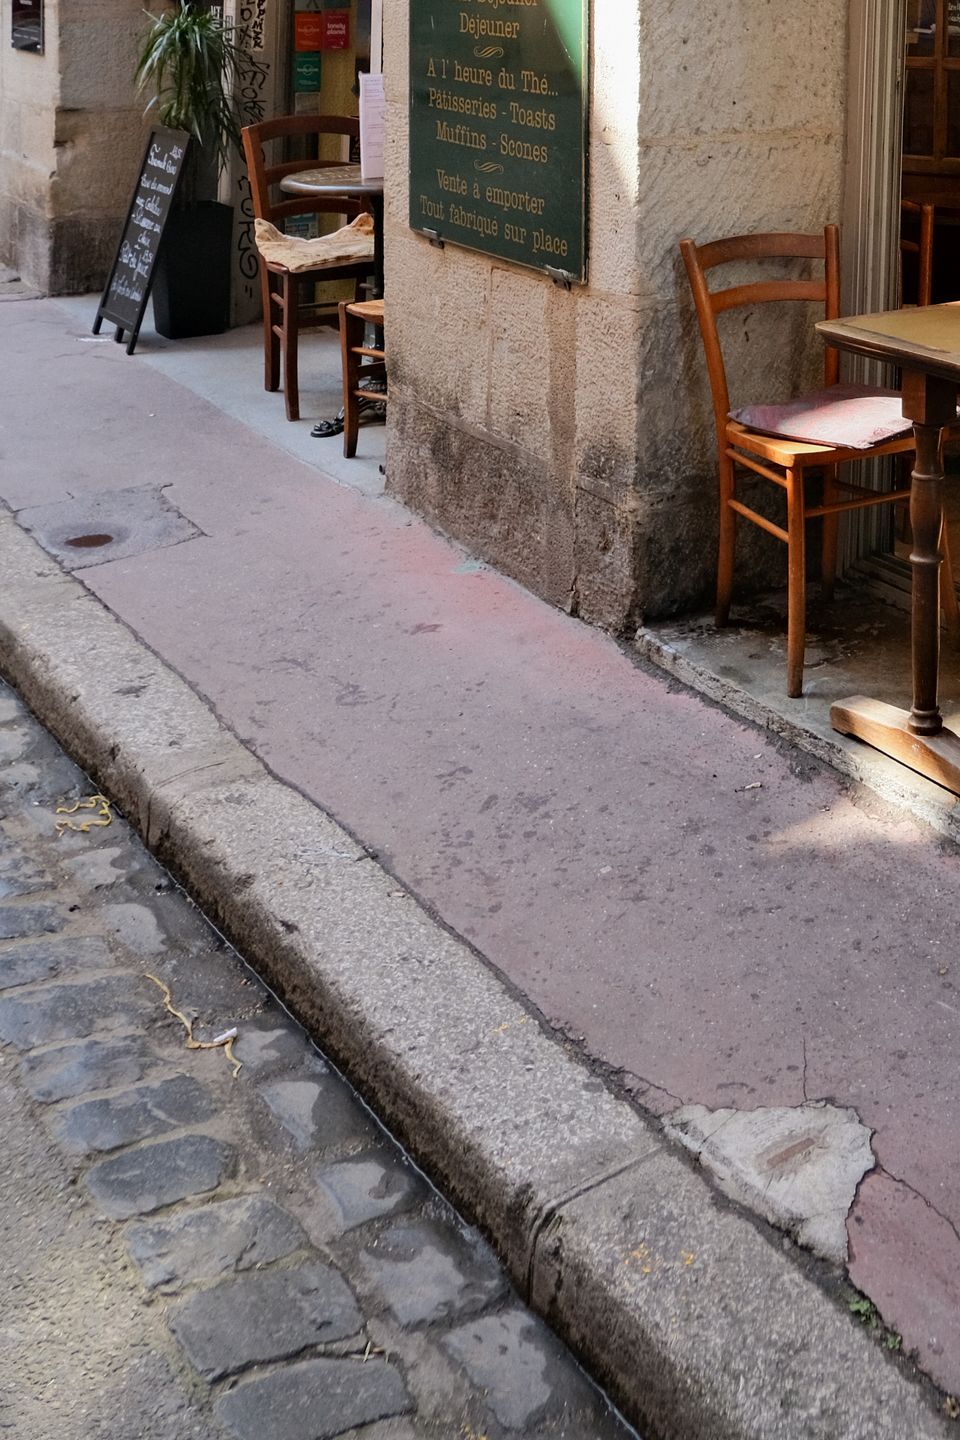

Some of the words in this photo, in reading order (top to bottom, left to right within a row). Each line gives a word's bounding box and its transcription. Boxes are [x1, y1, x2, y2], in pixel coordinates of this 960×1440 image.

[459, 12, 520, 40] Déjeuner
[454, 61, 492, 86] heure
[498, 68, 516, 90] du
[428, 87, 497, 120] Pâtisseries
[510, 102, 556, 131] Toasts
[436, 120, 487, 150] Muffins
[500, 133, 548, 163] Scones
[436, 168, 468, 196] Vente
[473, 178, 480, 199] à
[486, 185, 545, 215] emporter
[420, 195, 445, 220] Tout
[449, 203, 498, 238] fabriqué
[504, 222, 527, 244] sur
[532, 228, 568, 257] place
